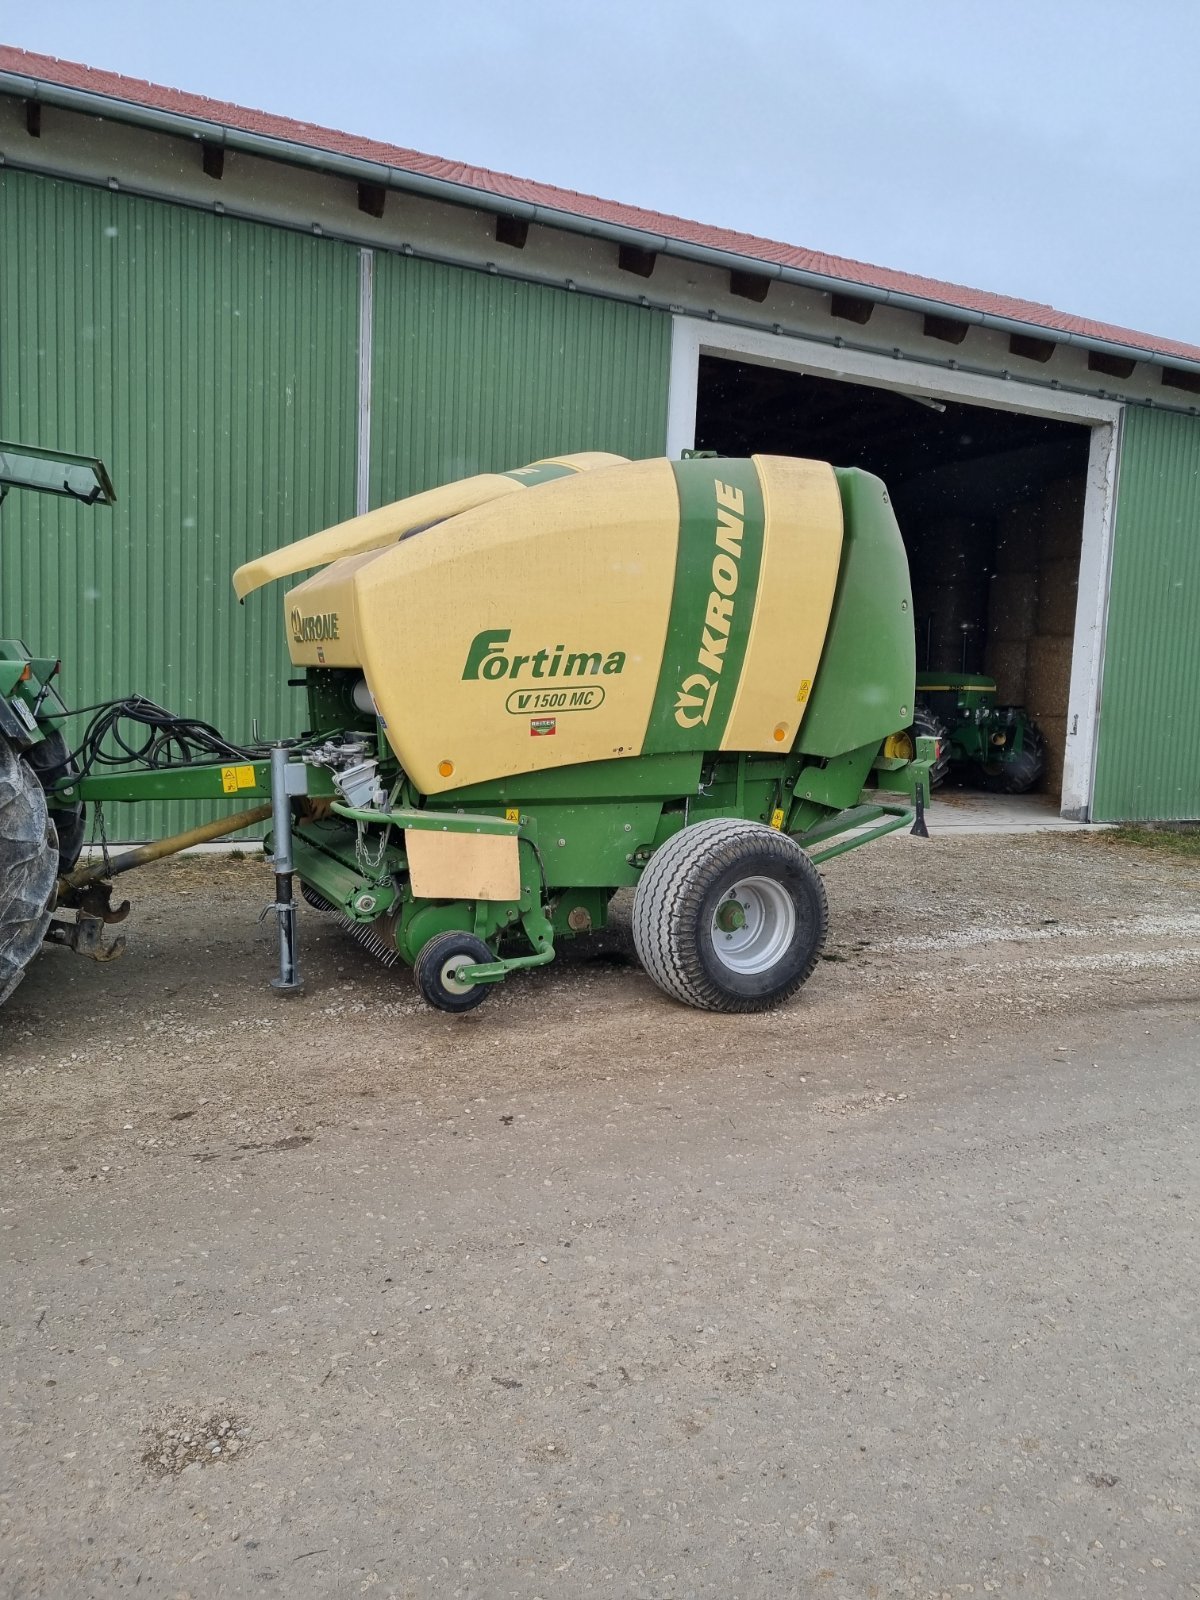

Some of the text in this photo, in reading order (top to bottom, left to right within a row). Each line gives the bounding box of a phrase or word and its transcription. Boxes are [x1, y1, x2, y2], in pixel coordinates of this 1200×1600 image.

[698, 479, 744, 674] KRONE
[301, 612, 340, 641] KRONE
[461, 628, 626, 680] Fortima
[517, 691, 595, 709] V 1500 MC
